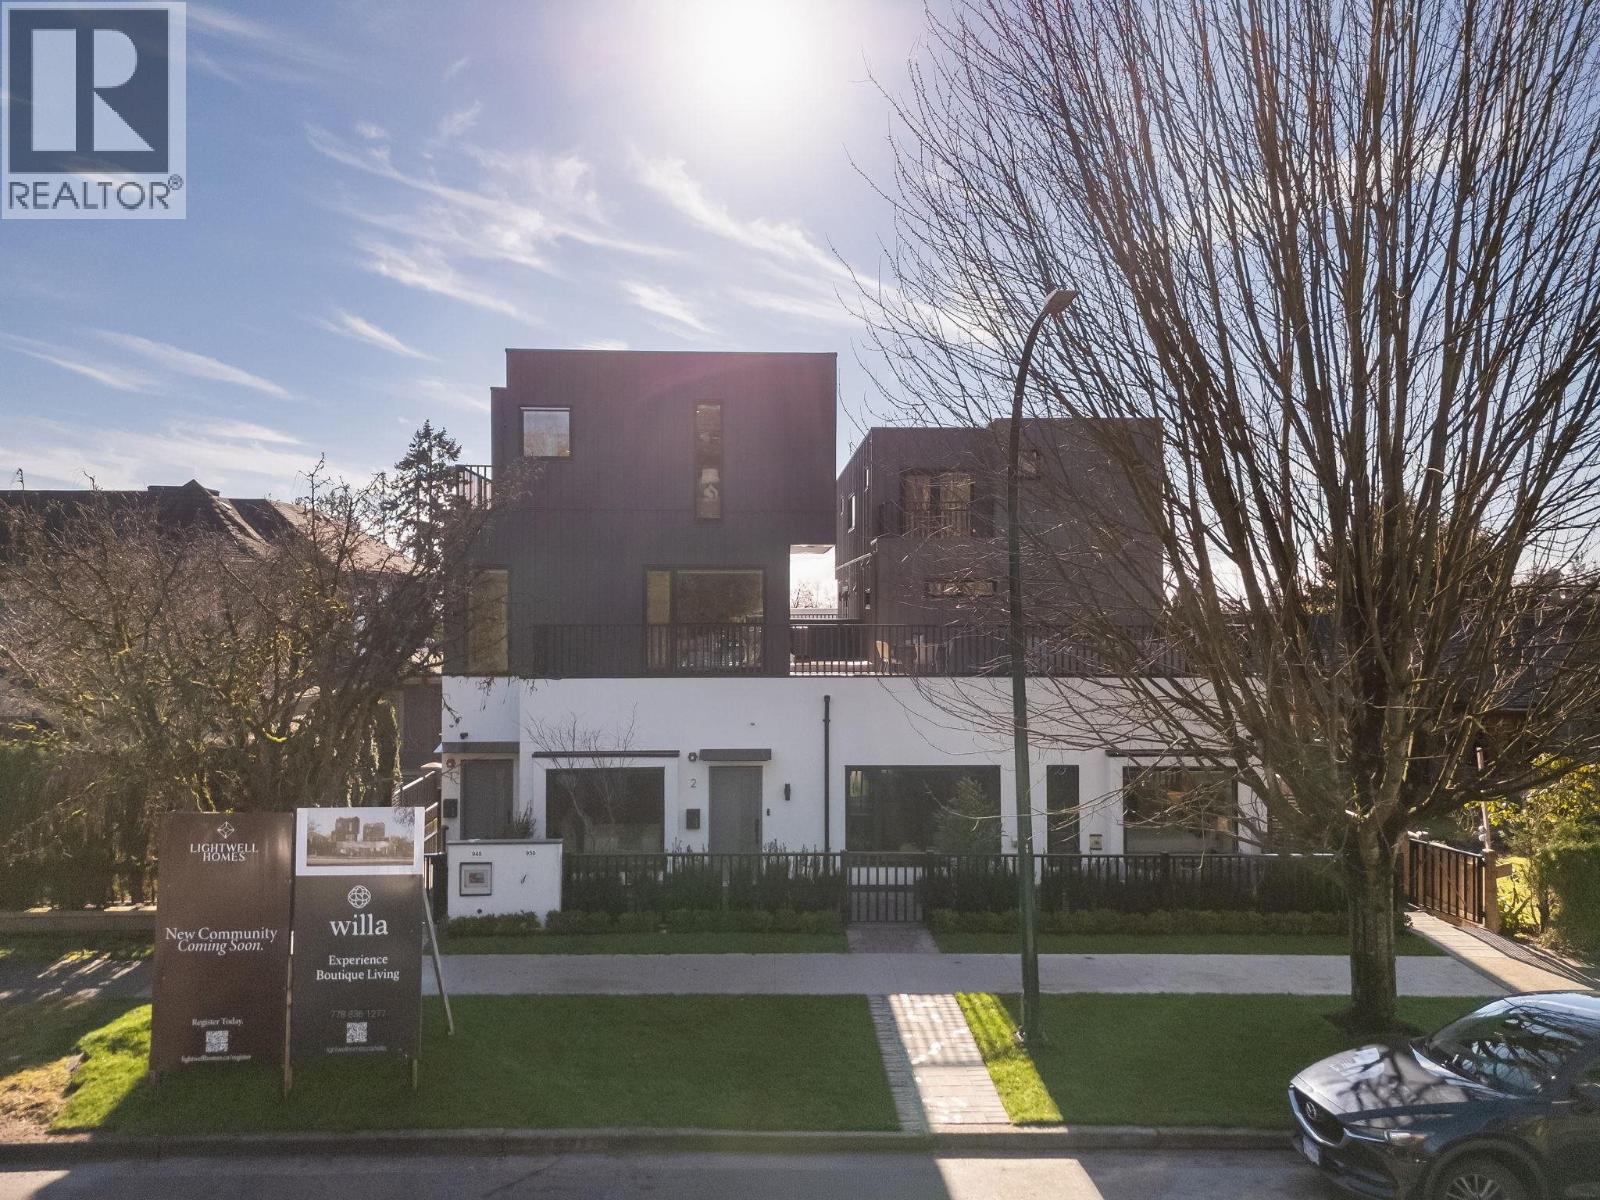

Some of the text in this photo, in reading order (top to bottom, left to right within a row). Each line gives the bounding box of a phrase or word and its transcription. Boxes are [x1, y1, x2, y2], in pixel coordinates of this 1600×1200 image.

[690, 778, 697, 788] 2
[190, 843, 258, 852] LIGHTWELL
[202, 852, 246, 862] HOMES
[329, 913, 389, 936] willa
[165, 927, 278, 942] New Community
[177, 938, 264, 956] Coming Soon.
[328, 954, 389, 967] Experience
[316, 968, 400, 982] Boutique Living
[192, 1018, 220, 1027] Register
